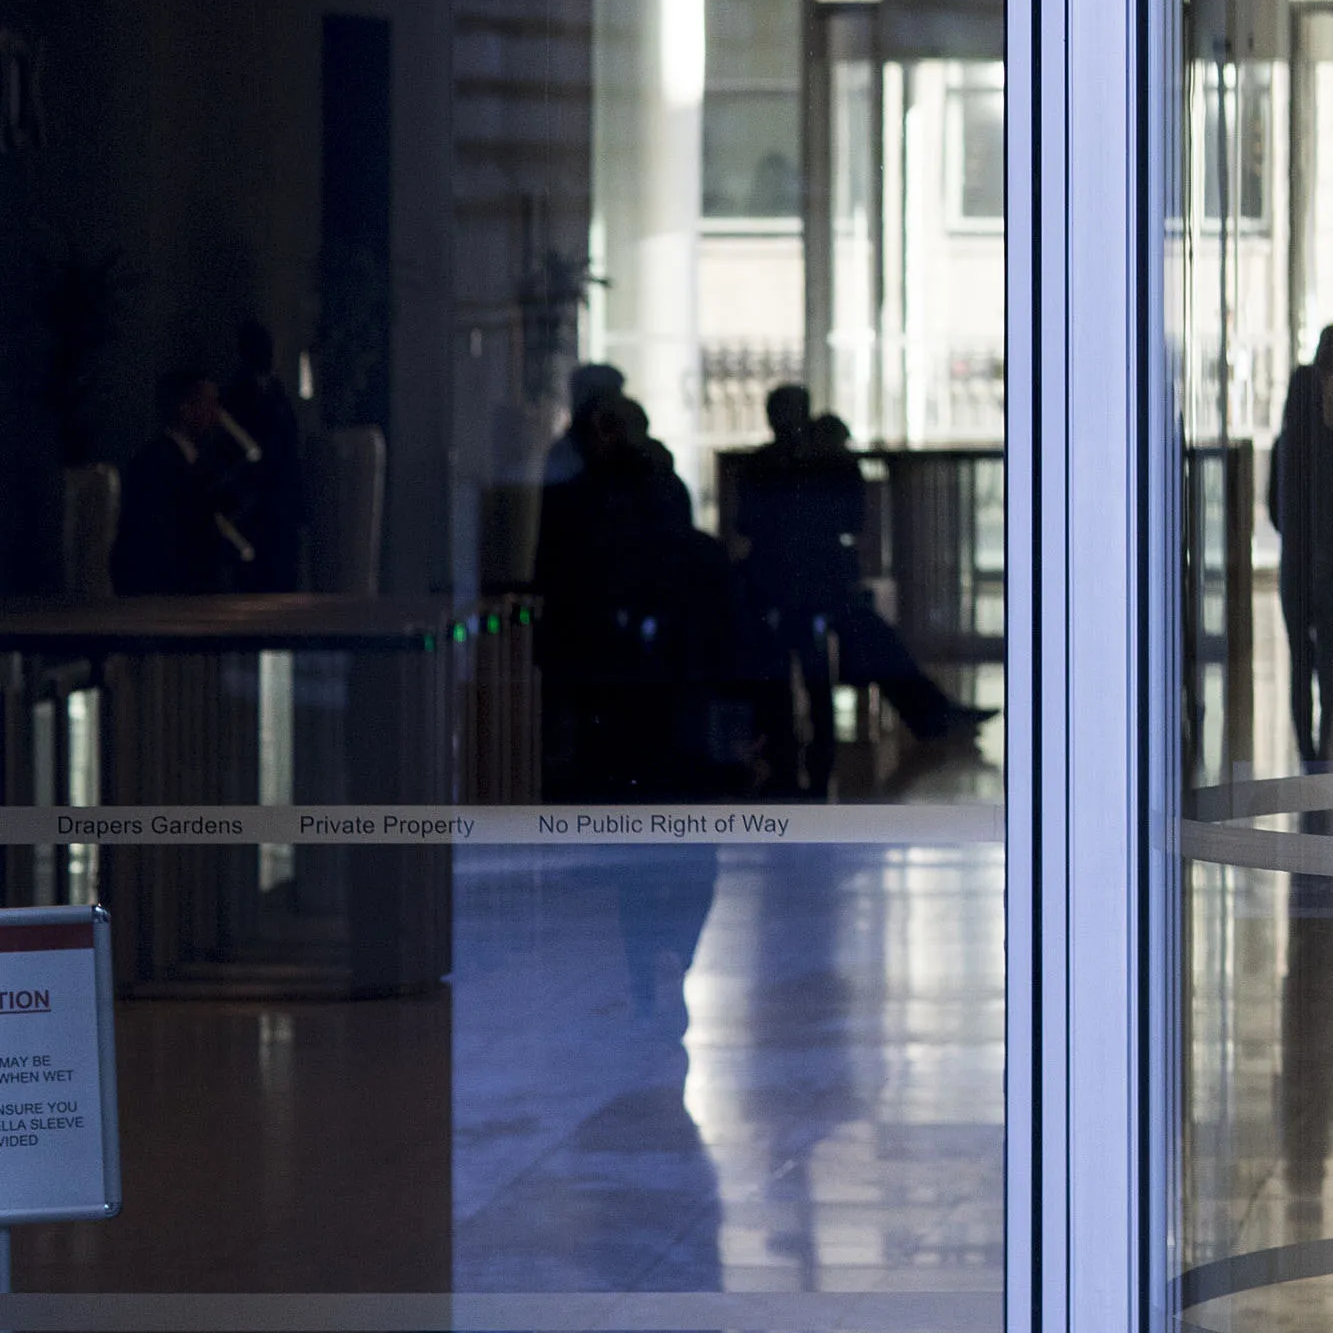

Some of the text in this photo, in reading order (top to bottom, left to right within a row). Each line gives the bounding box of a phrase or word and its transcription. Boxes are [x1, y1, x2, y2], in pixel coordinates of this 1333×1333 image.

[57, 814, 790, 838] Drapers Gardens Private Property No Public Right of Way
[0, 1054, 51, 1068] MAY BE
[42, 1069, 74, 1082] WET
[47, 1100, 78, 1114] YOU
[0, 1117, 85, 1132] LLA SLEEVE
